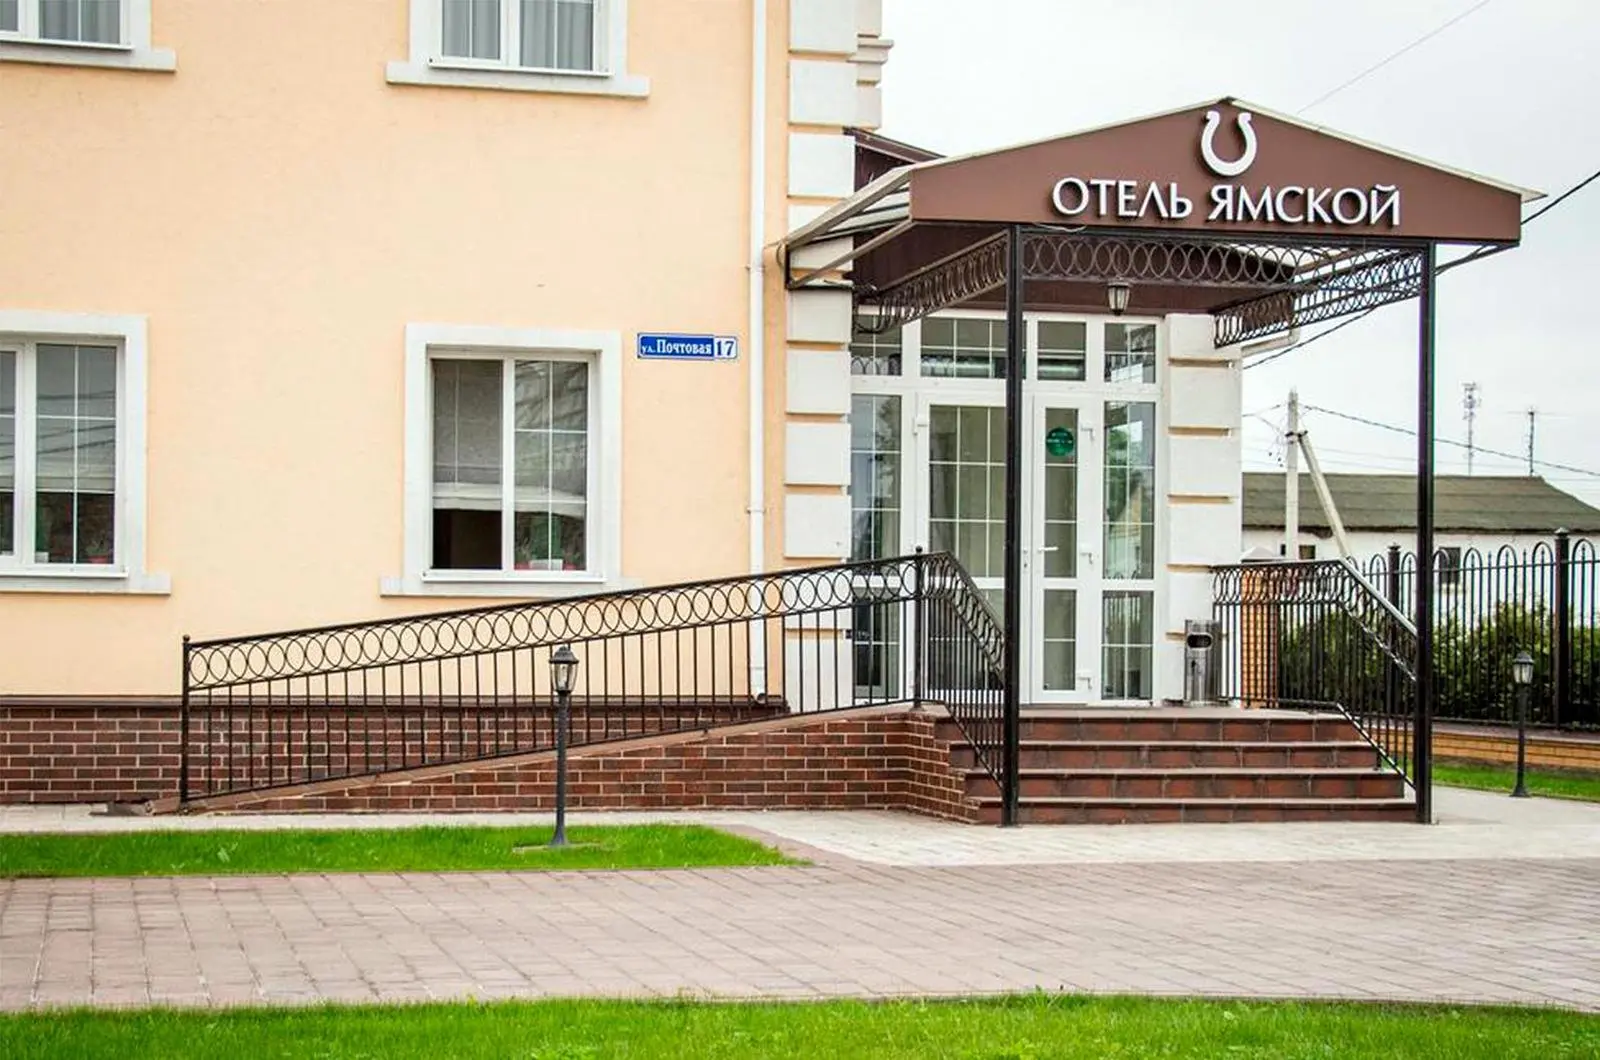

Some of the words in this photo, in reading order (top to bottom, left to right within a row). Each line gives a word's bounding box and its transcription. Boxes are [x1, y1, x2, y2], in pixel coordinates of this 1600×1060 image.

[1052, 177, 1193, 218] ОТЕЛЬ
[1208, 183, 1400, 225] ЯМСКОЙ
[656, 339, 712, 355] Почтовая
[716, 341, 734, 356] 17
